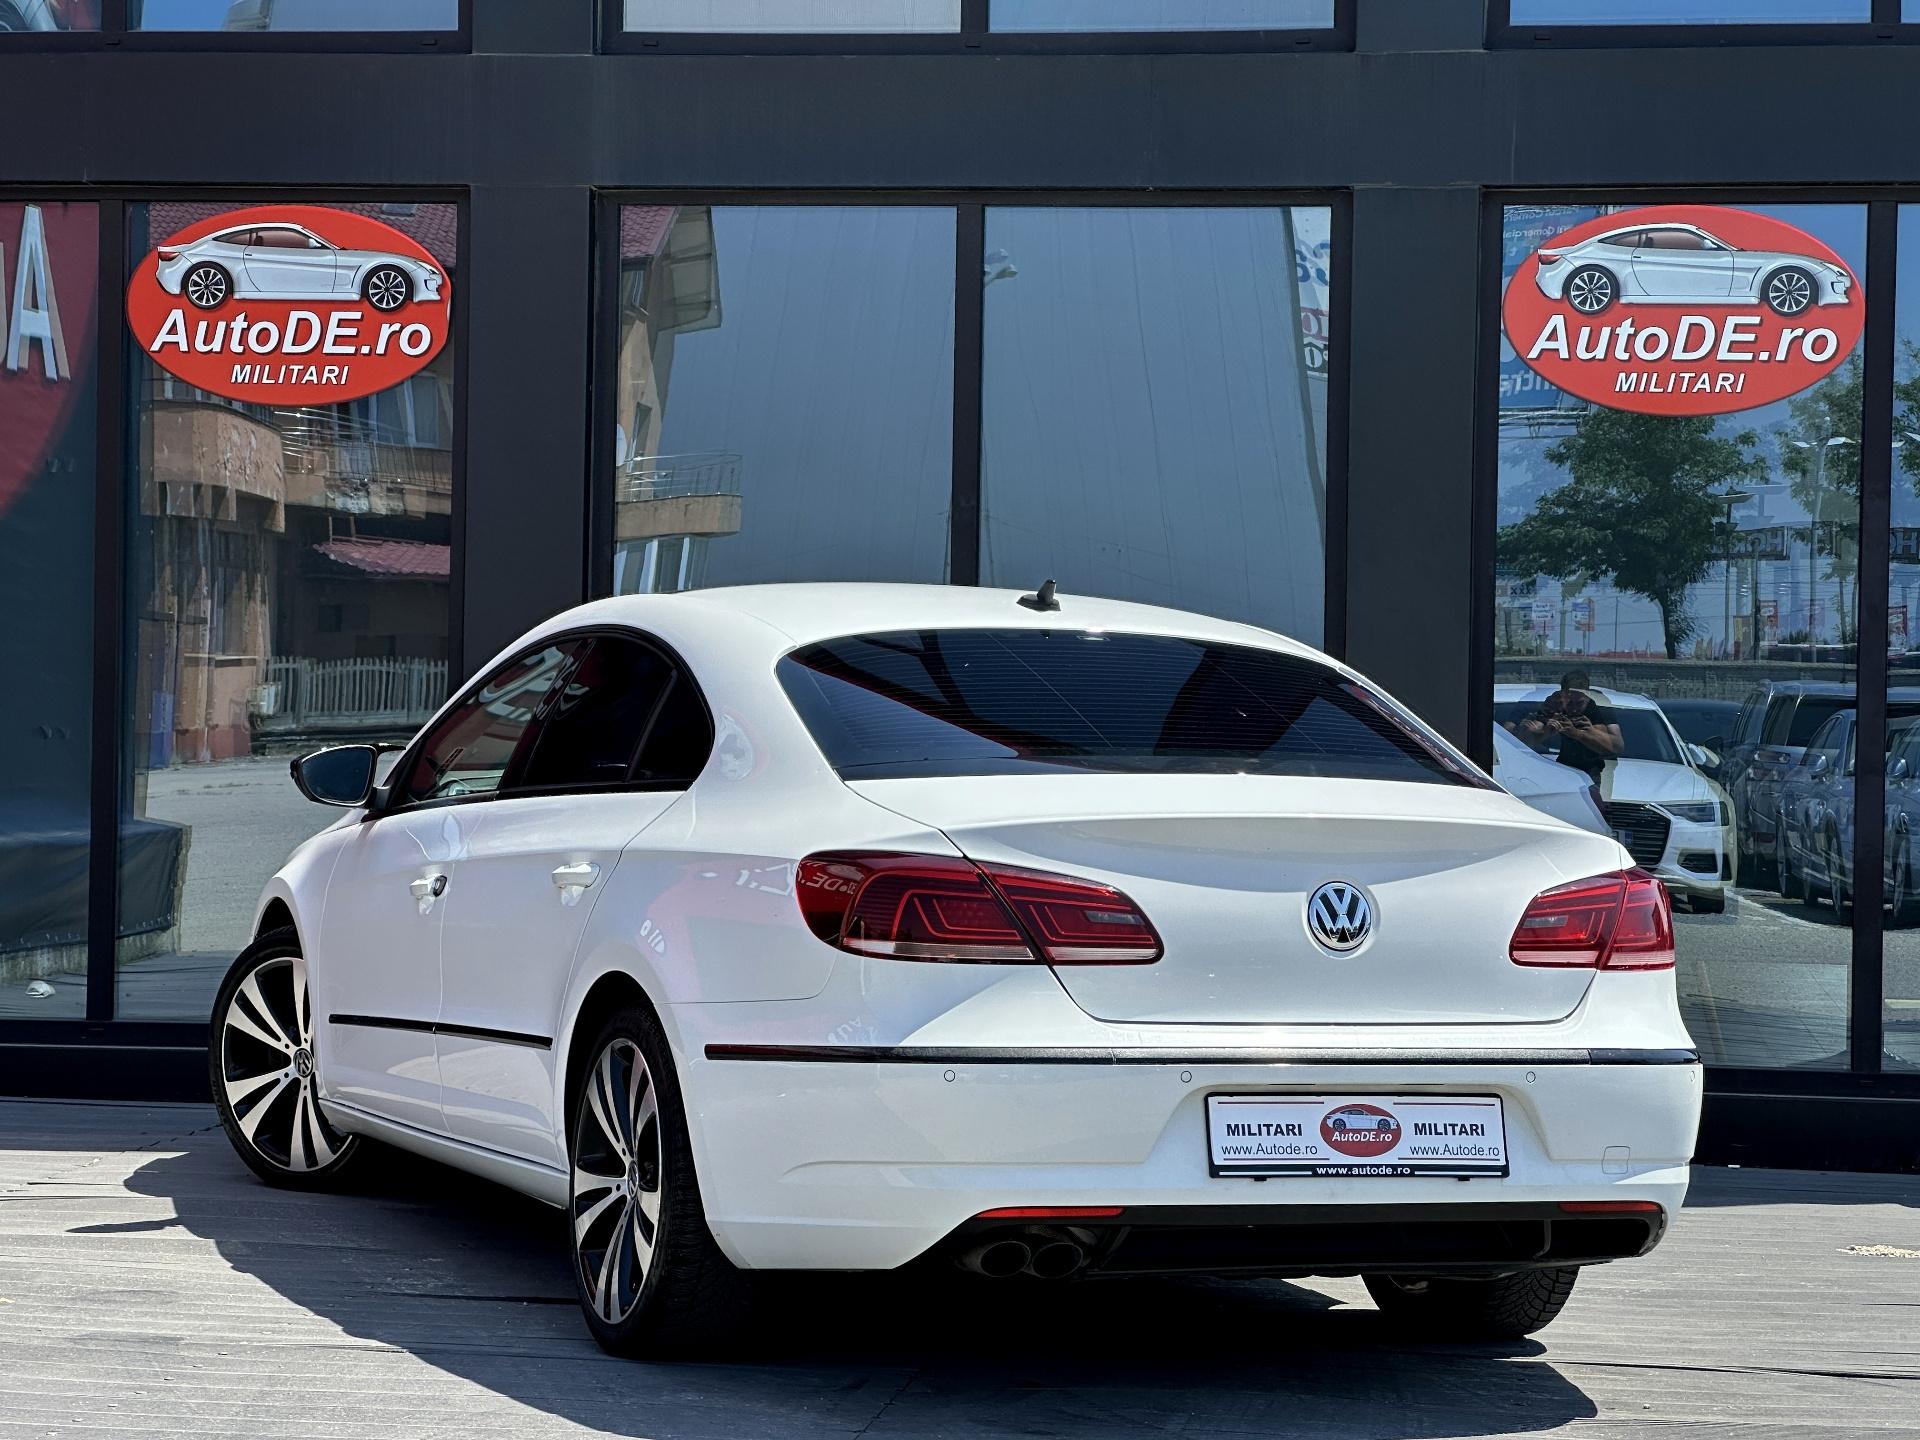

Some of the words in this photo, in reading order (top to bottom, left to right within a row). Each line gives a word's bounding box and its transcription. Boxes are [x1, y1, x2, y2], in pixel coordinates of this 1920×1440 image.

[150, 308, 432, 355] AutoDE.ro
[1527, 314, 1838, 362] AutoDE.ro
[231, 364, 348, 385] MILITARI
[1615, 372, 1745, 393] MILITARI
[1226, 1123, 1303, 1137] MILITARI
[1331, 1131, 1393, 1143] AutoDE.ro
[1413, 1123, 1486, 1137] MILITARI
[1221, 1143, 1318, 1156] www.Autode.ro
[1409, 1143, 1500, 1157] www.Autode.ro
[1316, 1165, 1411, 1176] www.autode.ro
